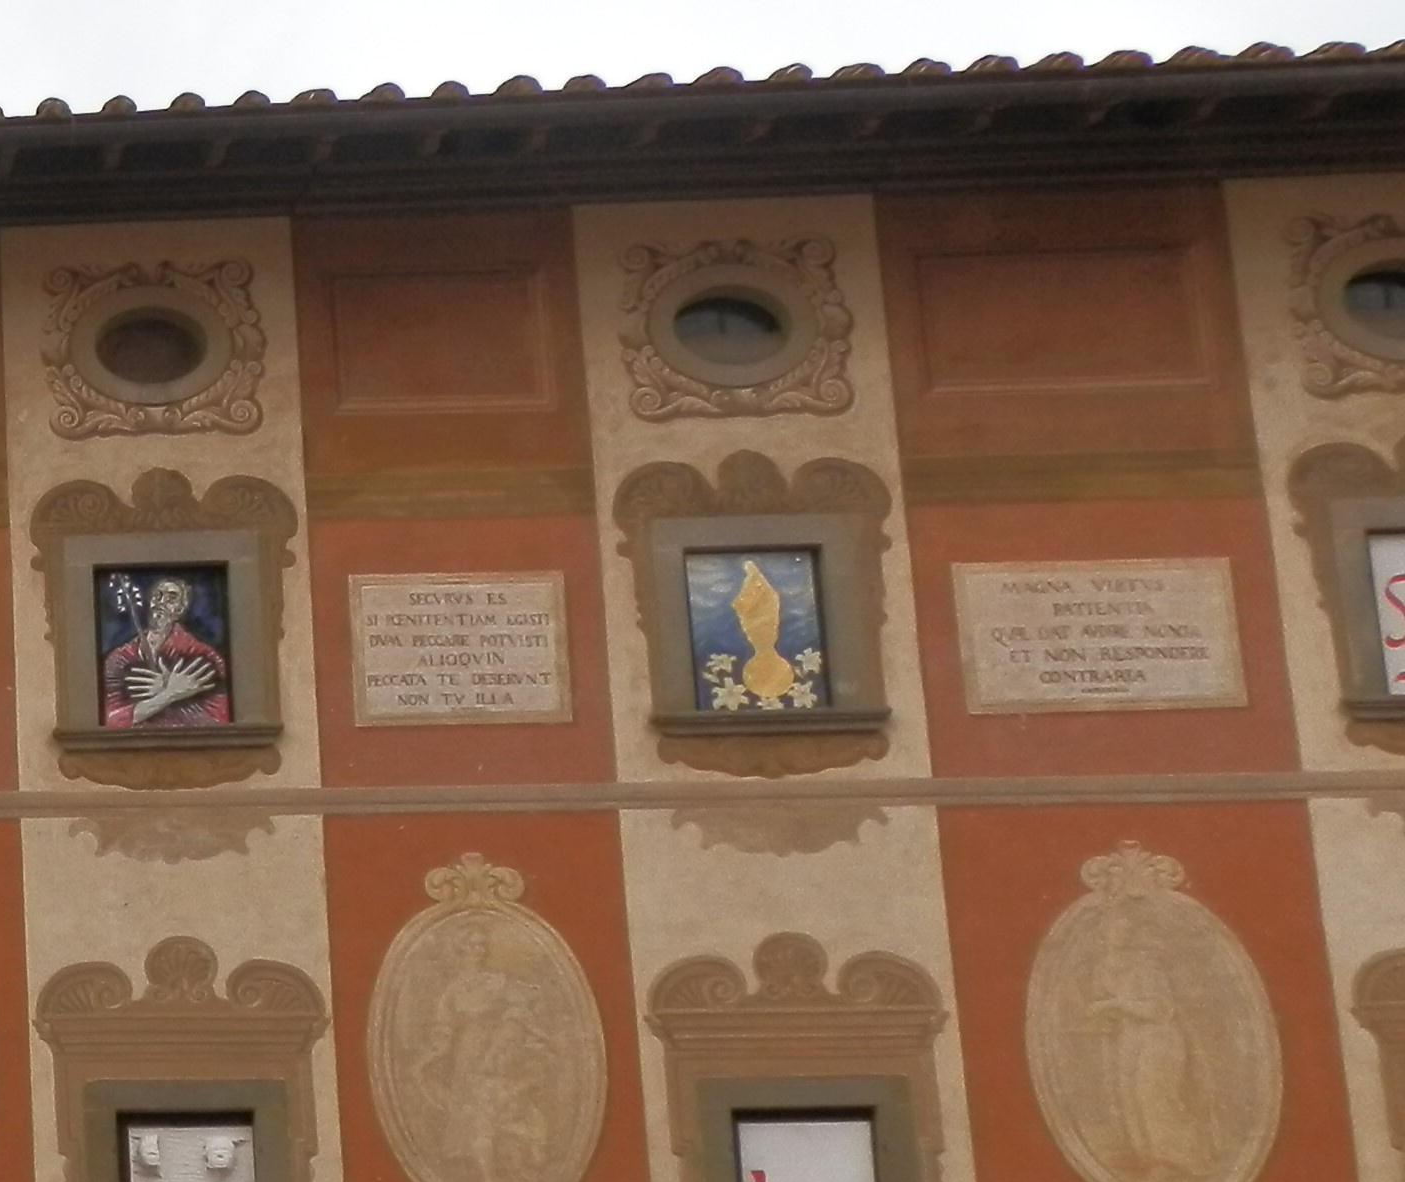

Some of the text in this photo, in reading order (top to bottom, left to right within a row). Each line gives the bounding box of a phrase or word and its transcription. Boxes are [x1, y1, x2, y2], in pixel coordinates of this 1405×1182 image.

[1001, 580, 1074, 595] MAGNA
[408, 591, 508, 606] SECVRVS ES
[1052, 601, 1155, 617] PATIENTIA
[366, 613, 379, 627] SI
[506, 612, 550, 627] EGISTI
[369, 633, 549, 649] DVM PECCARE POTVISTI
[417, 651, 506, 669] ALIOQVIN
[1009, 649, 1033, 664] ET
[1044, 647, 1087, 663] NON
[367, 672, 552, 688] PECCATA TE DESERVNT
[1039, 669, 1147, 685] CONTRARIA
[397, 692, 515, 707] NON TV ILLA
